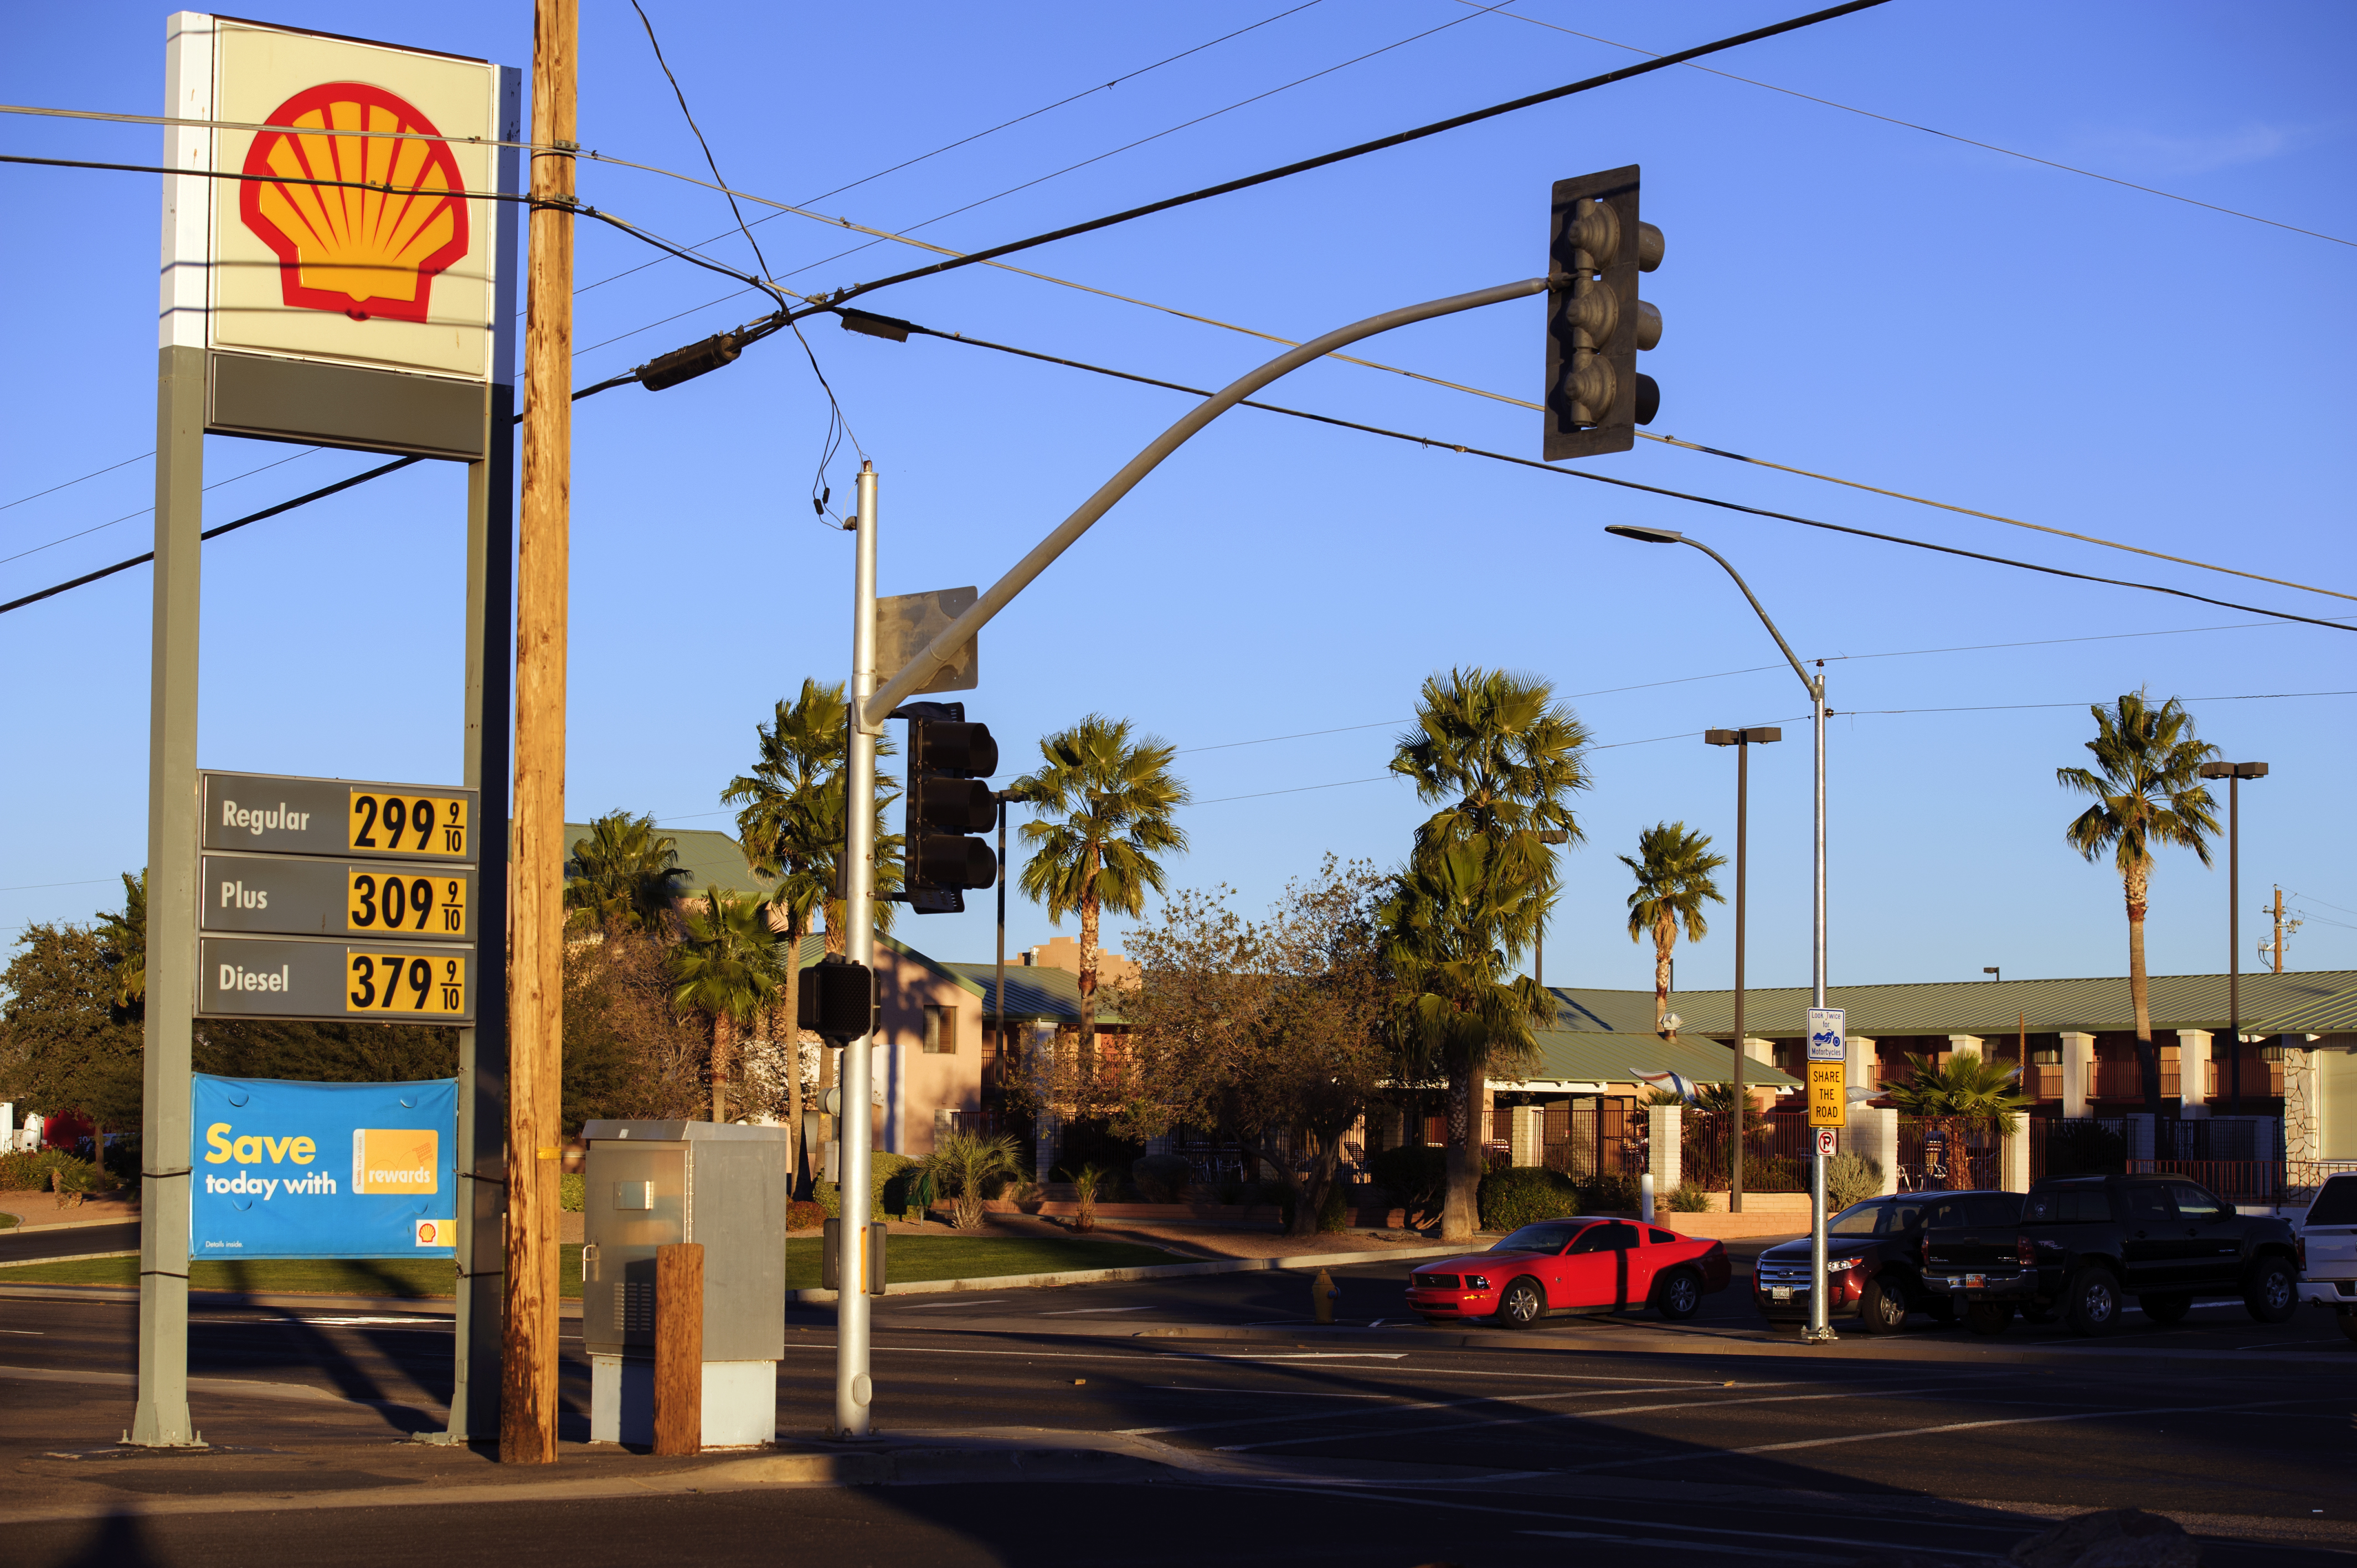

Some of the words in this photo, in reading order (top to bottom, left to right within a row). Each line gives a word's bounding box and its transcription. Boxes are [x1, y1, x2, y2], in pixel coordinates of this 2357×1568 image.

[223, 801, 309, 835] Regular
[354, 796, 435, 850] 299
[222, 881, 267, 909] Plus
[352, 875, 433, 930] 309
[220, 964, 288, 992] Diesel
[351, 956, 432, 1009] 379
[1812, 1048, 1841, 1057] Motorcycles
[1814, 1071, 1840, 1082] SHARE
[1820, 1089, 1834, 1100] THE
[1816, 1106, 1838, 1117] ROAD
[204, 1122, 316, 1164] Save
[205, 1170, 279, 1200] today
[283, 1171, 337, 1194] with
[369, 1167, 430, 1183] rewards
